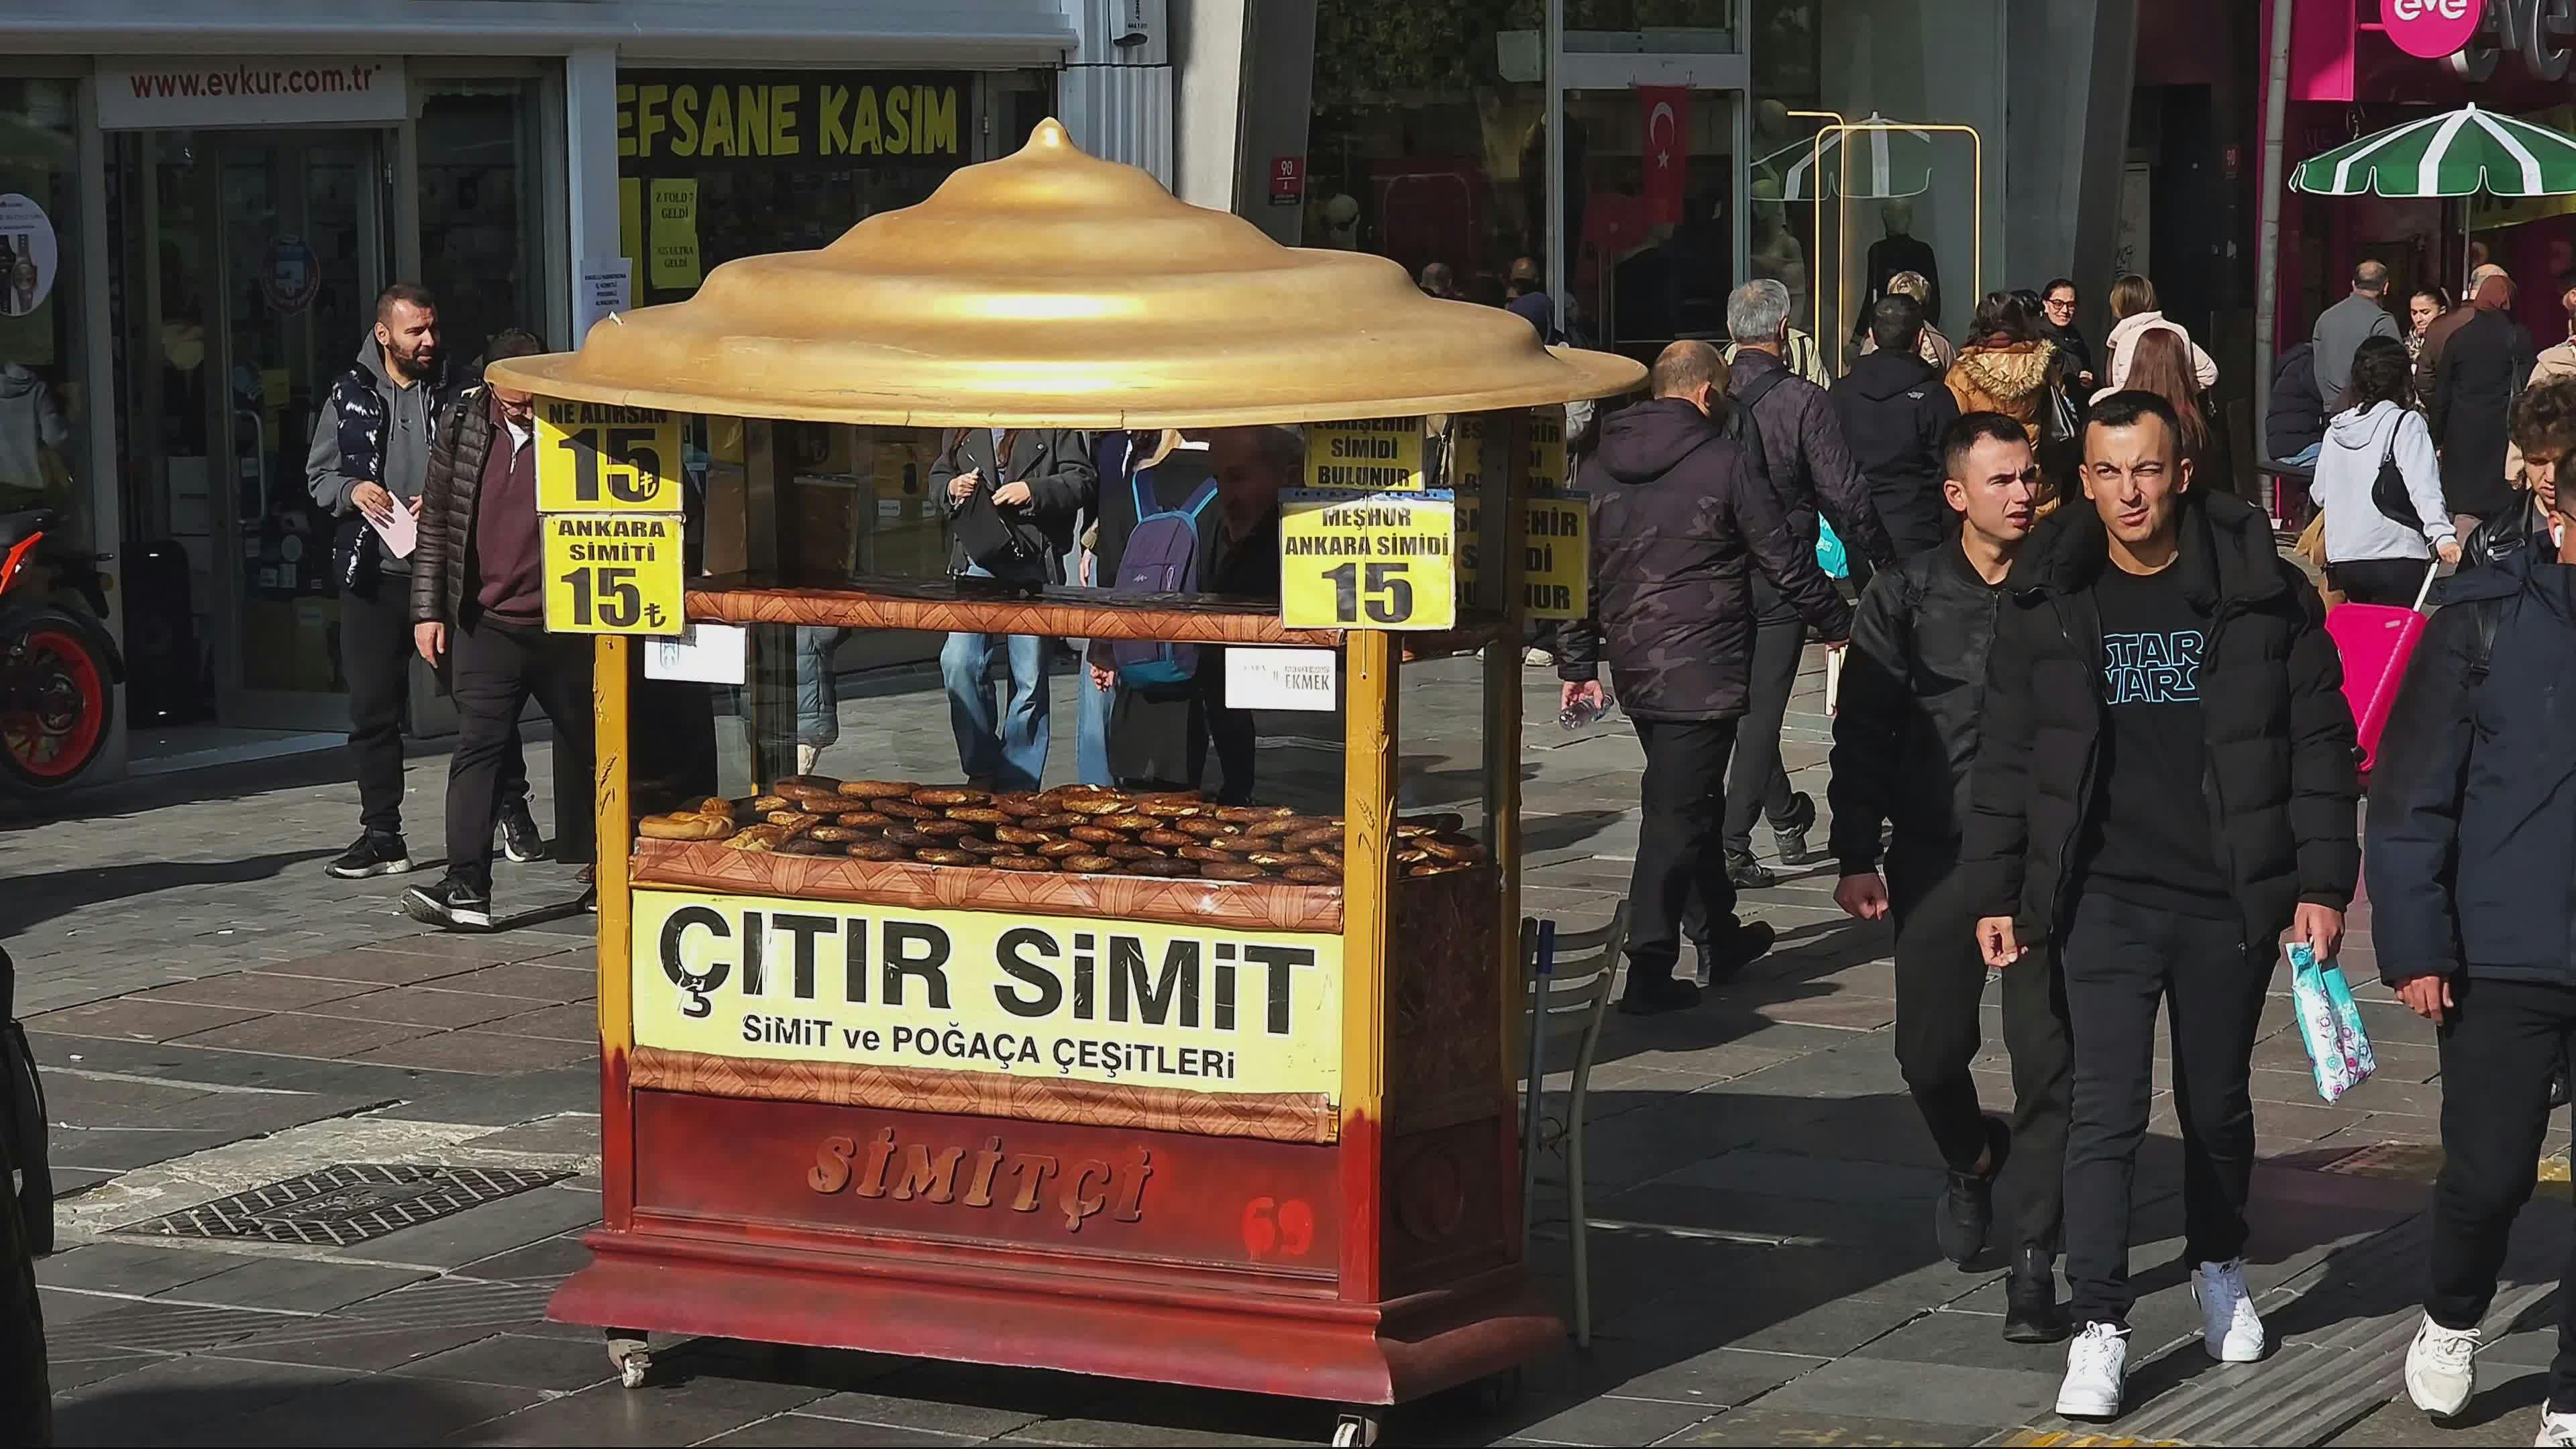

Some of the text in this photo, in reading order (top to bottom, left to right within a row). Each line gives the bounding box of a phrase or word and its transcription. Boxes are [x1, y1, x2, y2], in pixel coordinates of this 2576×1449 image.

[131, 64, 373, 99] www.evkur.com.tr
[616, 85, 957, 156] EFSANE KASIM
[1281, 160, 1293, 176] 90
[549, 404, 575, 423] NE
[1318, 466, 1410, 487] BULUNUR
[558, 520, 665, 538] ANKARA
[1322, 508, 1411, 531] MEŞHUR
[570, 542, 655, 561] SİMİTİ
[1285, 533, 1449, 556] ANKARA SİMİDİ
[1322, 562, 1413, 623] 15
[660, 906, 951, 1018] ÇITIR
[843, 1028, 881, 1051] ve
[892, 1021, 1040, 1069] POĞAÇA
[1243, 1197, 1313, 1257] 69
